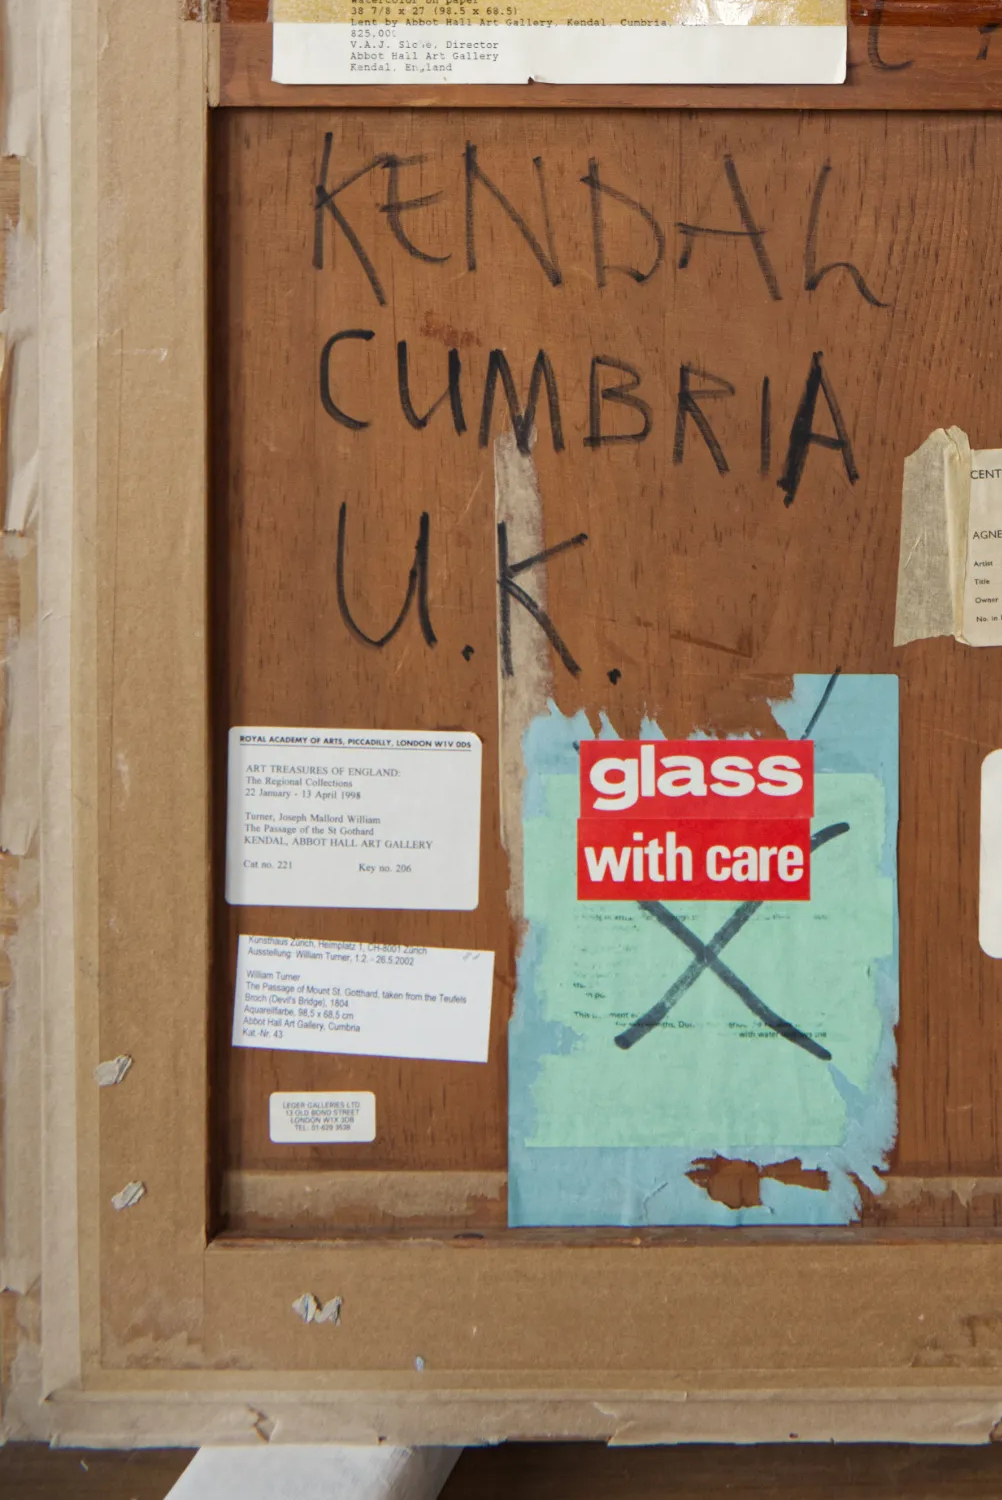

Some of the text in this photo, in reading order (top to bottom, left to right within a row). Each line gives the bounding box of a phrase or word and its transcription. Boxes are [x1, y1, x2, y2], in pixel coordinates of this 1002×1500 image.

[315, 132, 891, 308] KENDAL
[320, 328, 860, 508] CUMBRIA
[240, 735, 266, 743] ROYAL
[269, 736, 308, 744] ACADEMY
[348, 738, 394, 747] PICCADILLY,
[589, 744, 804, 811] glass
[584, 831, 804, 883] with care
